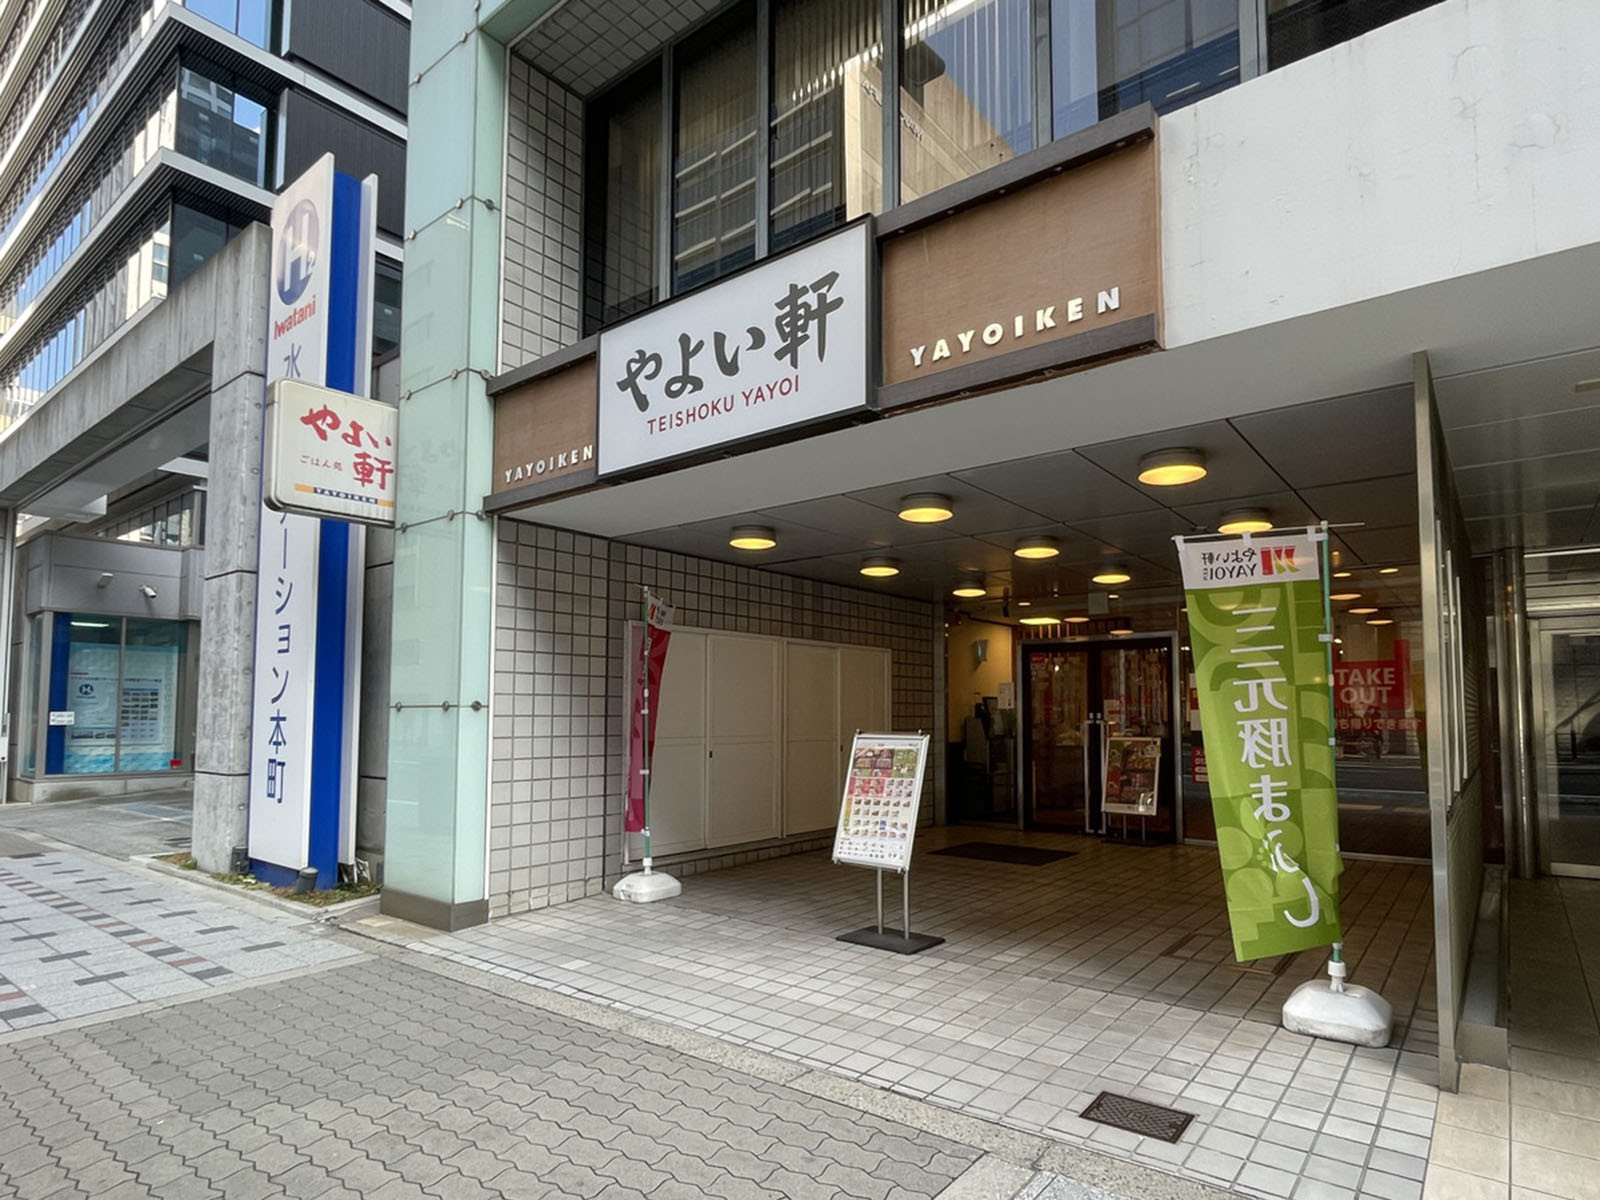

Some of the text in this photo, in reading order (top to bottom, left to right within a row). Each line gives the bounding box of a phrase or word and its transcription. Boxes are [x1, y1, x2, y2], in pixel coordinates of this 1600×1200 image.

[273, 295, 317, 340] Iwatani
[909, 286, 1120, 367] YAYOIKEN
[616, 271, 844, 412] やよい軒
[300, 404, 392, 449] やよい
[647, 374, 799, 435] TEISHOKU YAYOI
[353, 451, 394, 490] 軒
[505, 444, 593, 483] YAYOIKEN
[1334, 667, 1396, 686] TAKE
[1340, 686, 1393, 704] OUT
